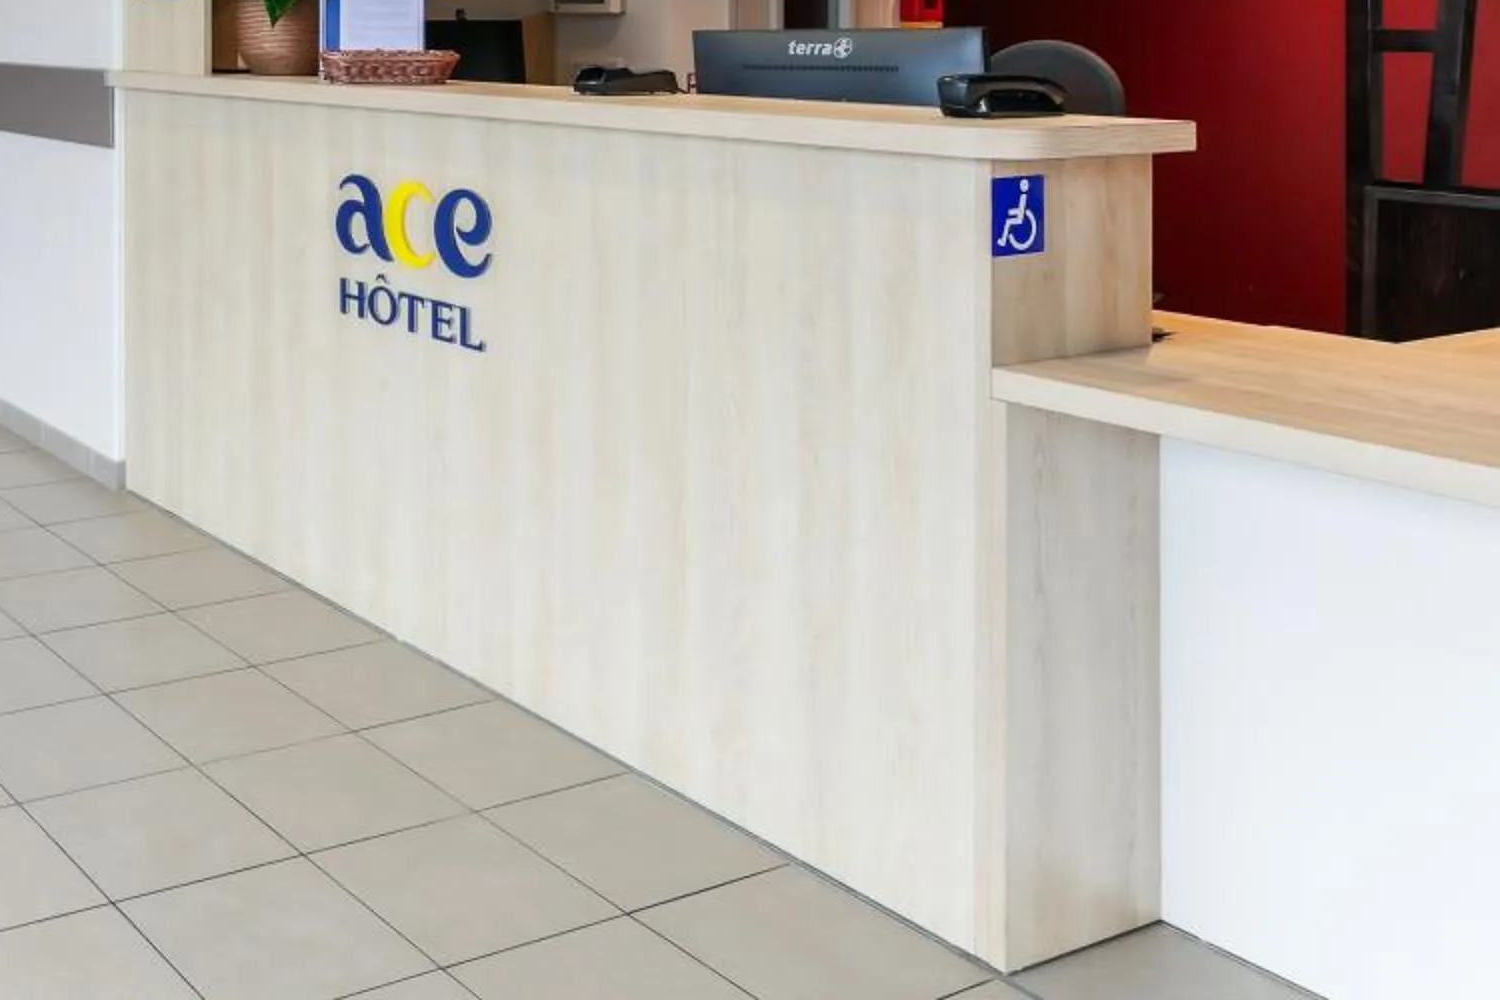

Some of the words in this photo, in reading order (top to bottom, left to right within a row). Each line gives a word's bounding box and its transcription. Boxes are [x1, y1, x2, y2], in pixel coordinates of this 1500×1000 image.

[788, 40, 833, 56] terra
[335, 173, 492, 278] ace
[339, 273, 486, 352] HÔTEL
